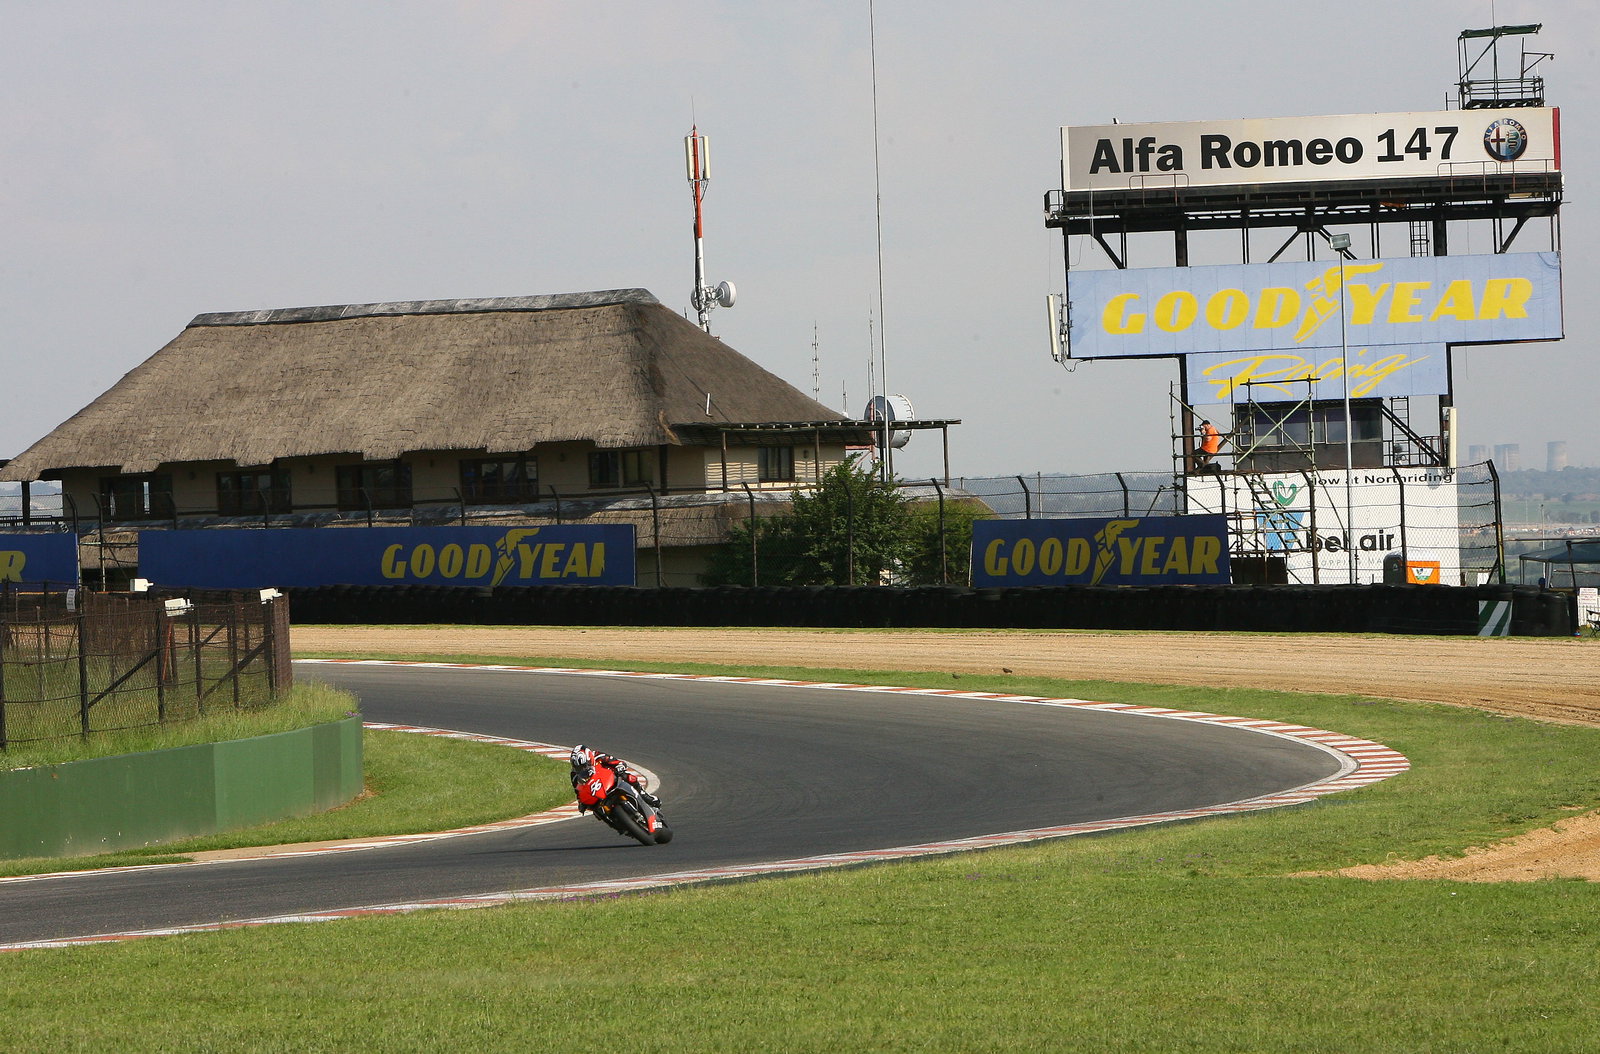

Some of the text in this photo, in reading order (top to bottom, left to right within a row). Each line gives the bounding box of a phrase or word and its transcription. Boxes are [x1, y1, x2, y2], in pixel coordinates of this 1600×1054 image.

[1089, 126, 1459, 174] Alfa Romeo 147
[1364, 473, 1453, 484] Northriding
[1359, 529, 1395, 551] air
